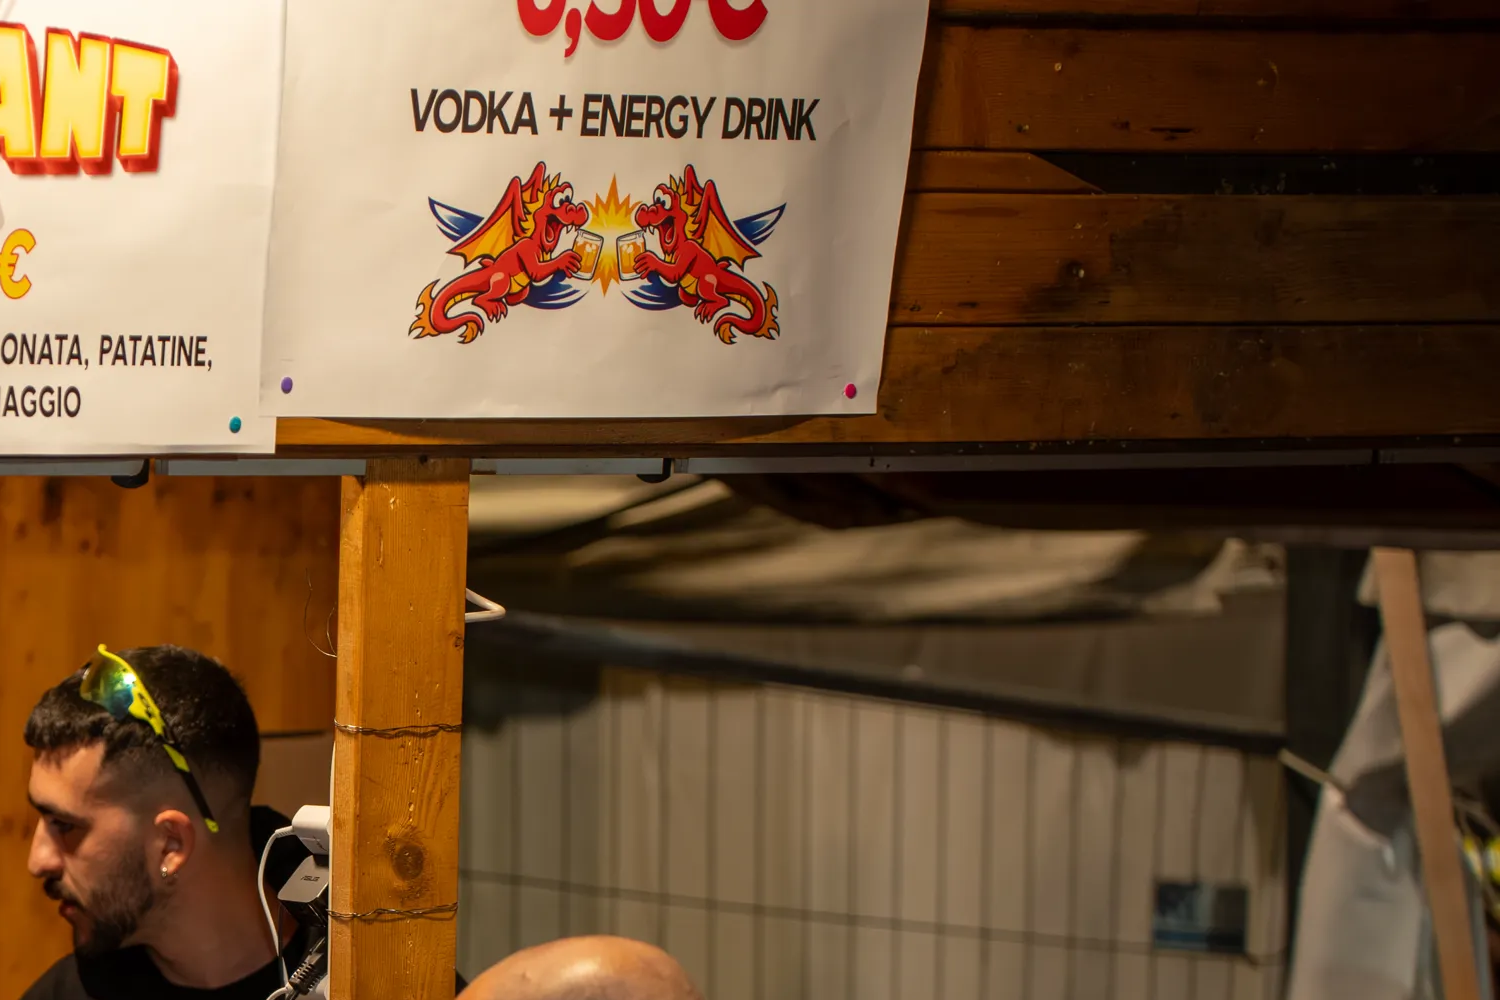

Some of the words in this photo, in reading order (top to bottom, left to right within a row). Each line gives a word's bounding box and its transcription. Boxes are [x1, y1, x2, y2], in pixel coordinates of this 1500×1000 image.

[411, 88, 538, 135] VODKA
[549, 94, 573, 131] +
[580, 94, 717, 139] ENERGY
[722, 97, 821, 141] DRINK
[99, 334, 213, 372] PATATINE,
